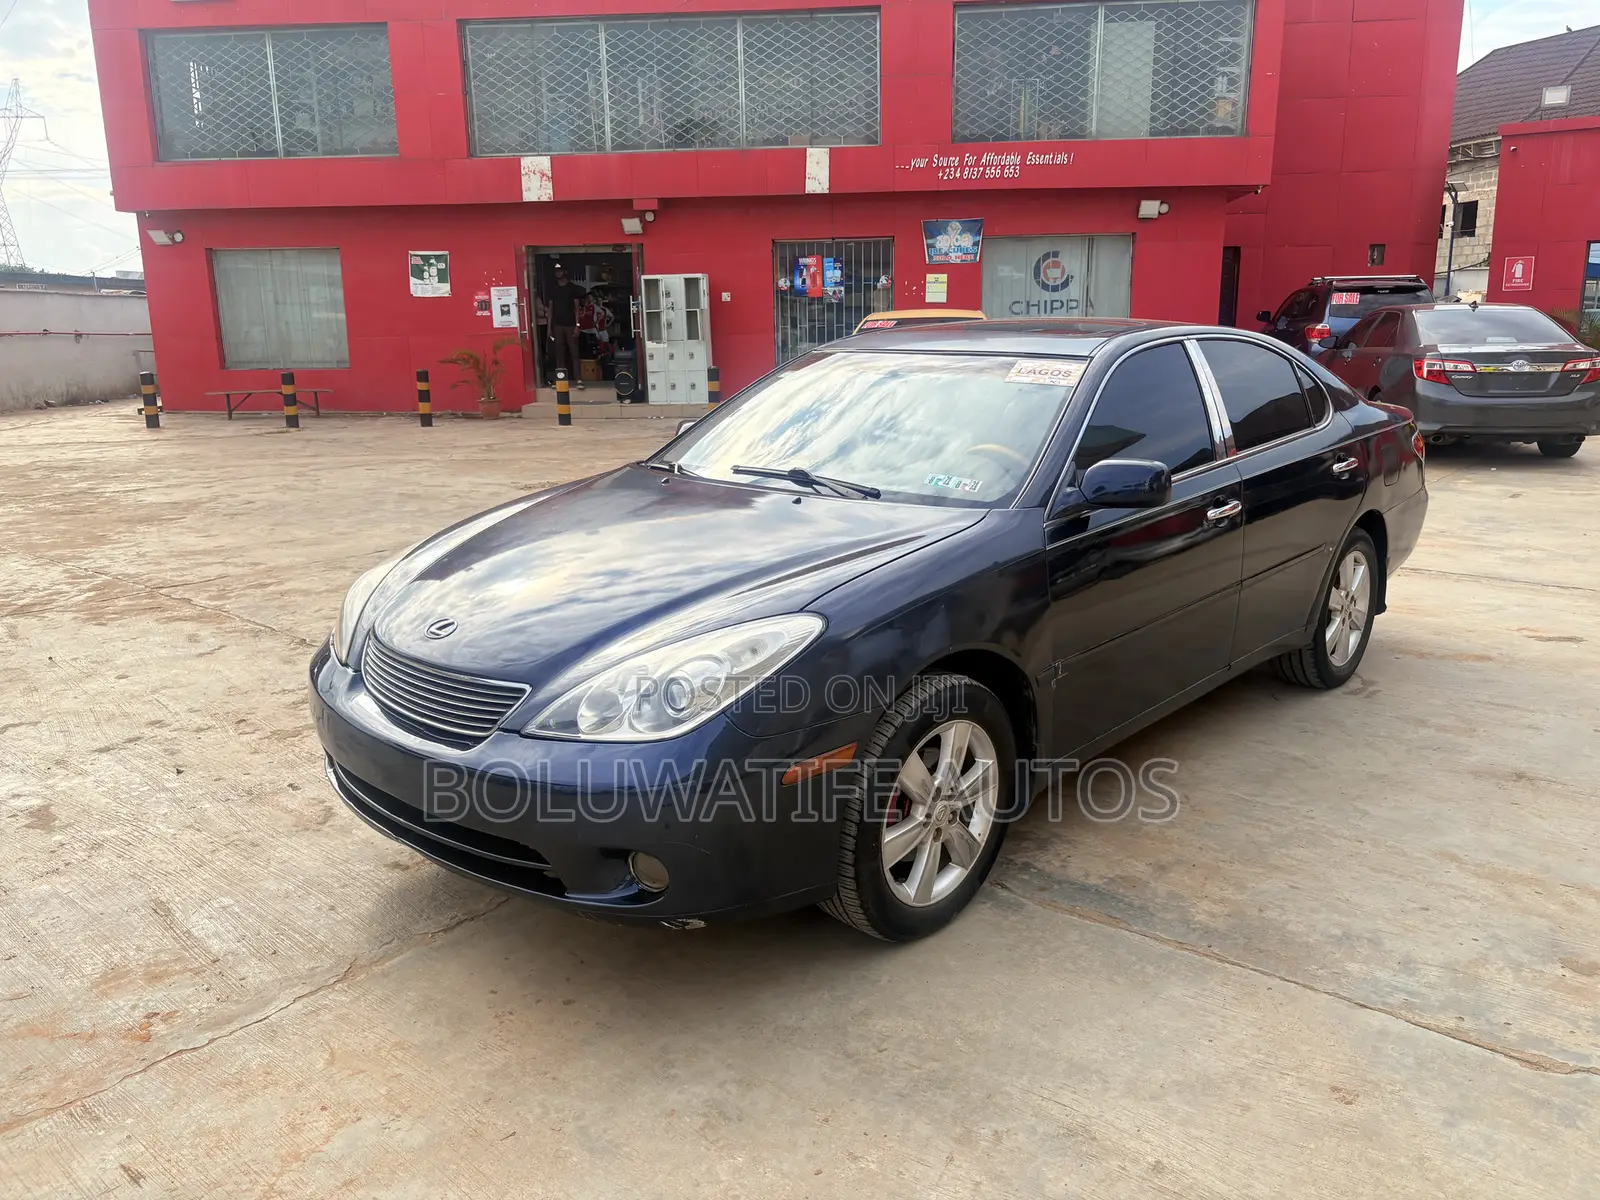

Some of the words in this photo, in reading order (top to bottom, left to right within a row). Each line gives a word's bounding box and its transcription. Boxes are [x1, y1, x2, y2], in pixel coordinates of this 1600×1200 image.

[932, 153, 960, 168] Source
[963, 153, 977, 166] For
[979, 152, 1021, 166] Affordable
[937, 167, 961, 180] +234
[962, 166, 983, 180] 8137
[984, 166, 1001, 179] 556
[1003, 166, 1020, 178] 653
[1332, 293, 1344, 303] FOR
[1345, 293, 1359, 303] SALE
[1017, 366, 1073, 378] LAGOS
